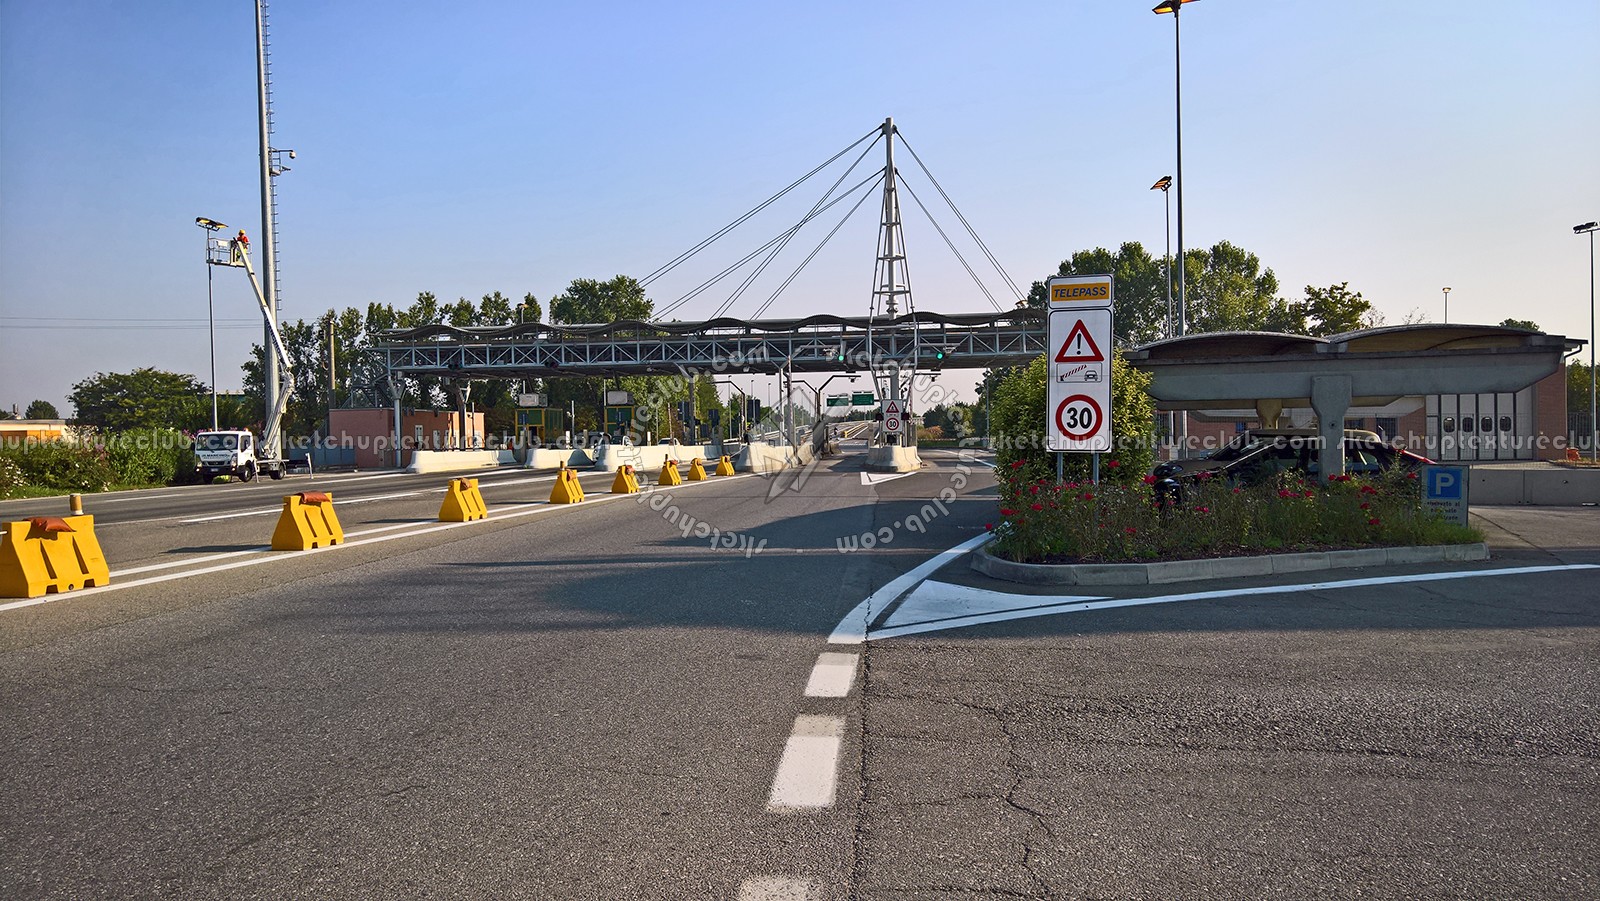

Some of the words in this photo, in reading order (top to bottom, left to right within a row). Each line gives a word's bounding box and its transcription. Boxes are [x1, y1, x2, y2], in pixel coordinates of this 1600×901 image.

[1054, 286, 1107, 298] TELEPASS
[1066, 407, 1092, 429] 30
[1436, 473, 1455, 495] P
